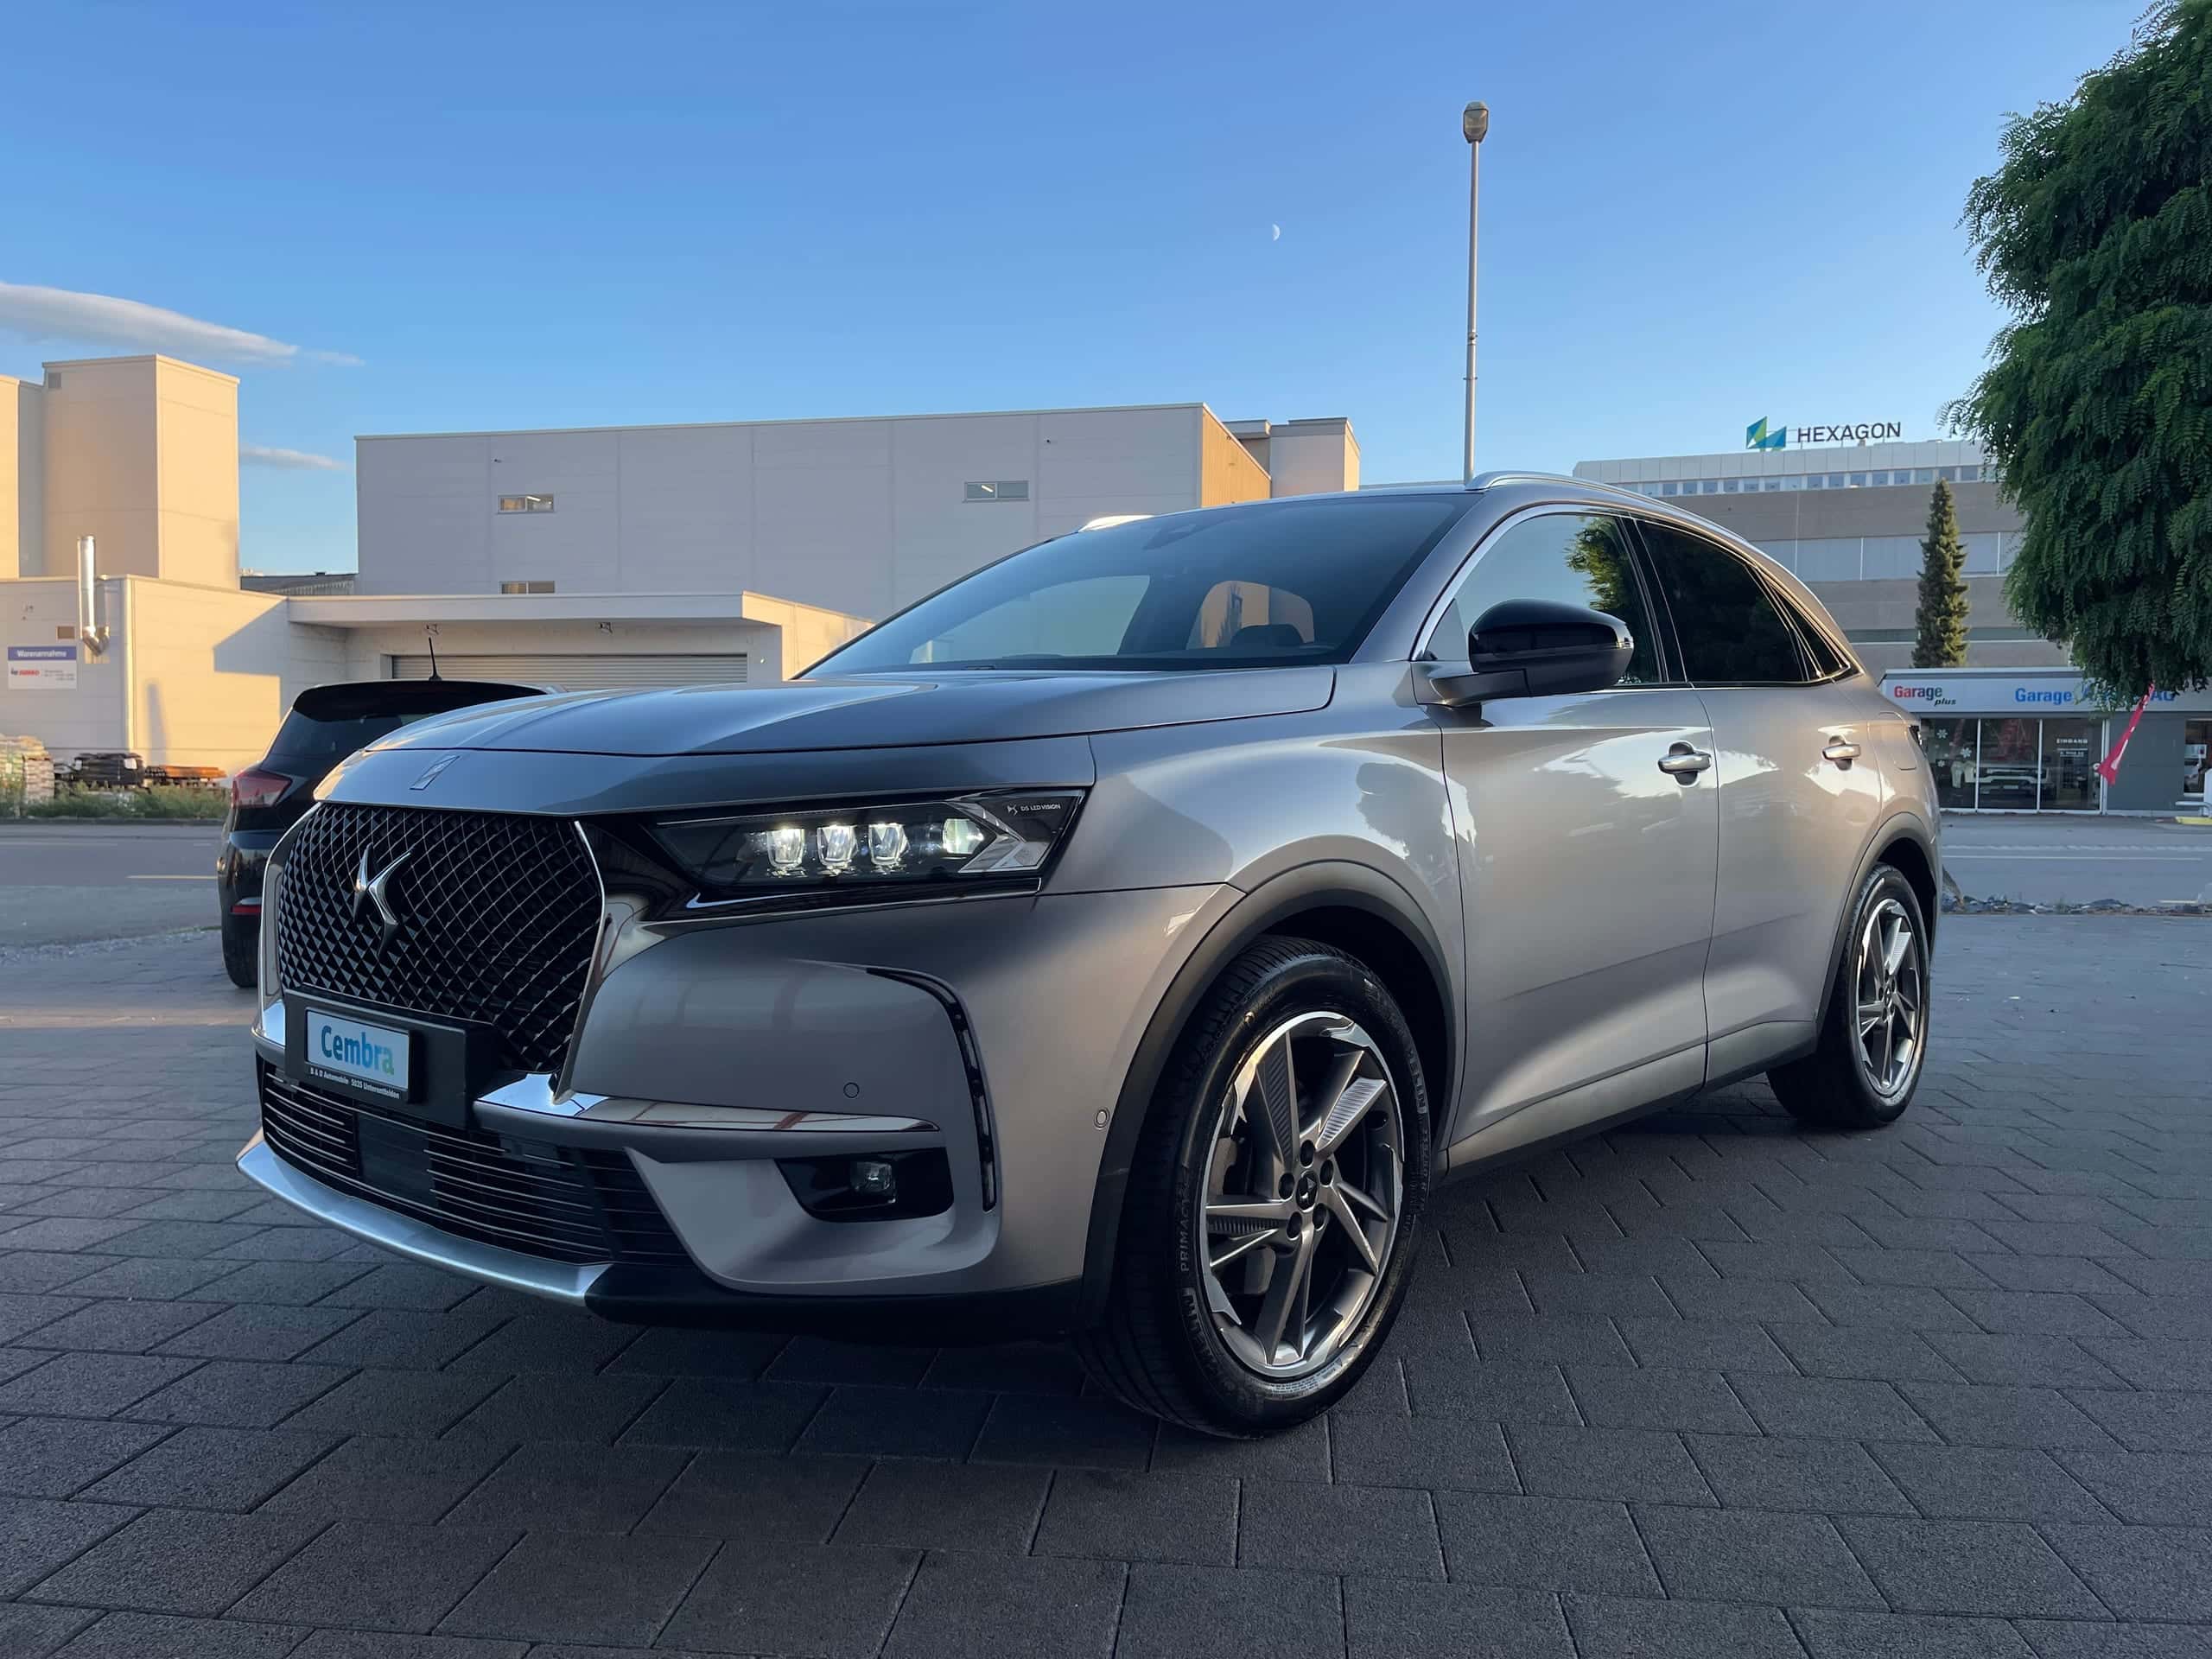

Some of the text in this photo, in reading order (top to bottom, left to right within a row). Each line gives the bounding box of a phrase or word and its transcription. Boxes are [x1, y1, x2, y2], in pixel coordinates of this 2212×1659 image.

[1797, 422, 1901, 443] HEXAGON
[1894, 685, 1942, 701] Garage
[2015, 688, 2072, 705] Garage
[1934, 698, 1956, 707] plus
[321, 1025, 395, 1075] Cembra
